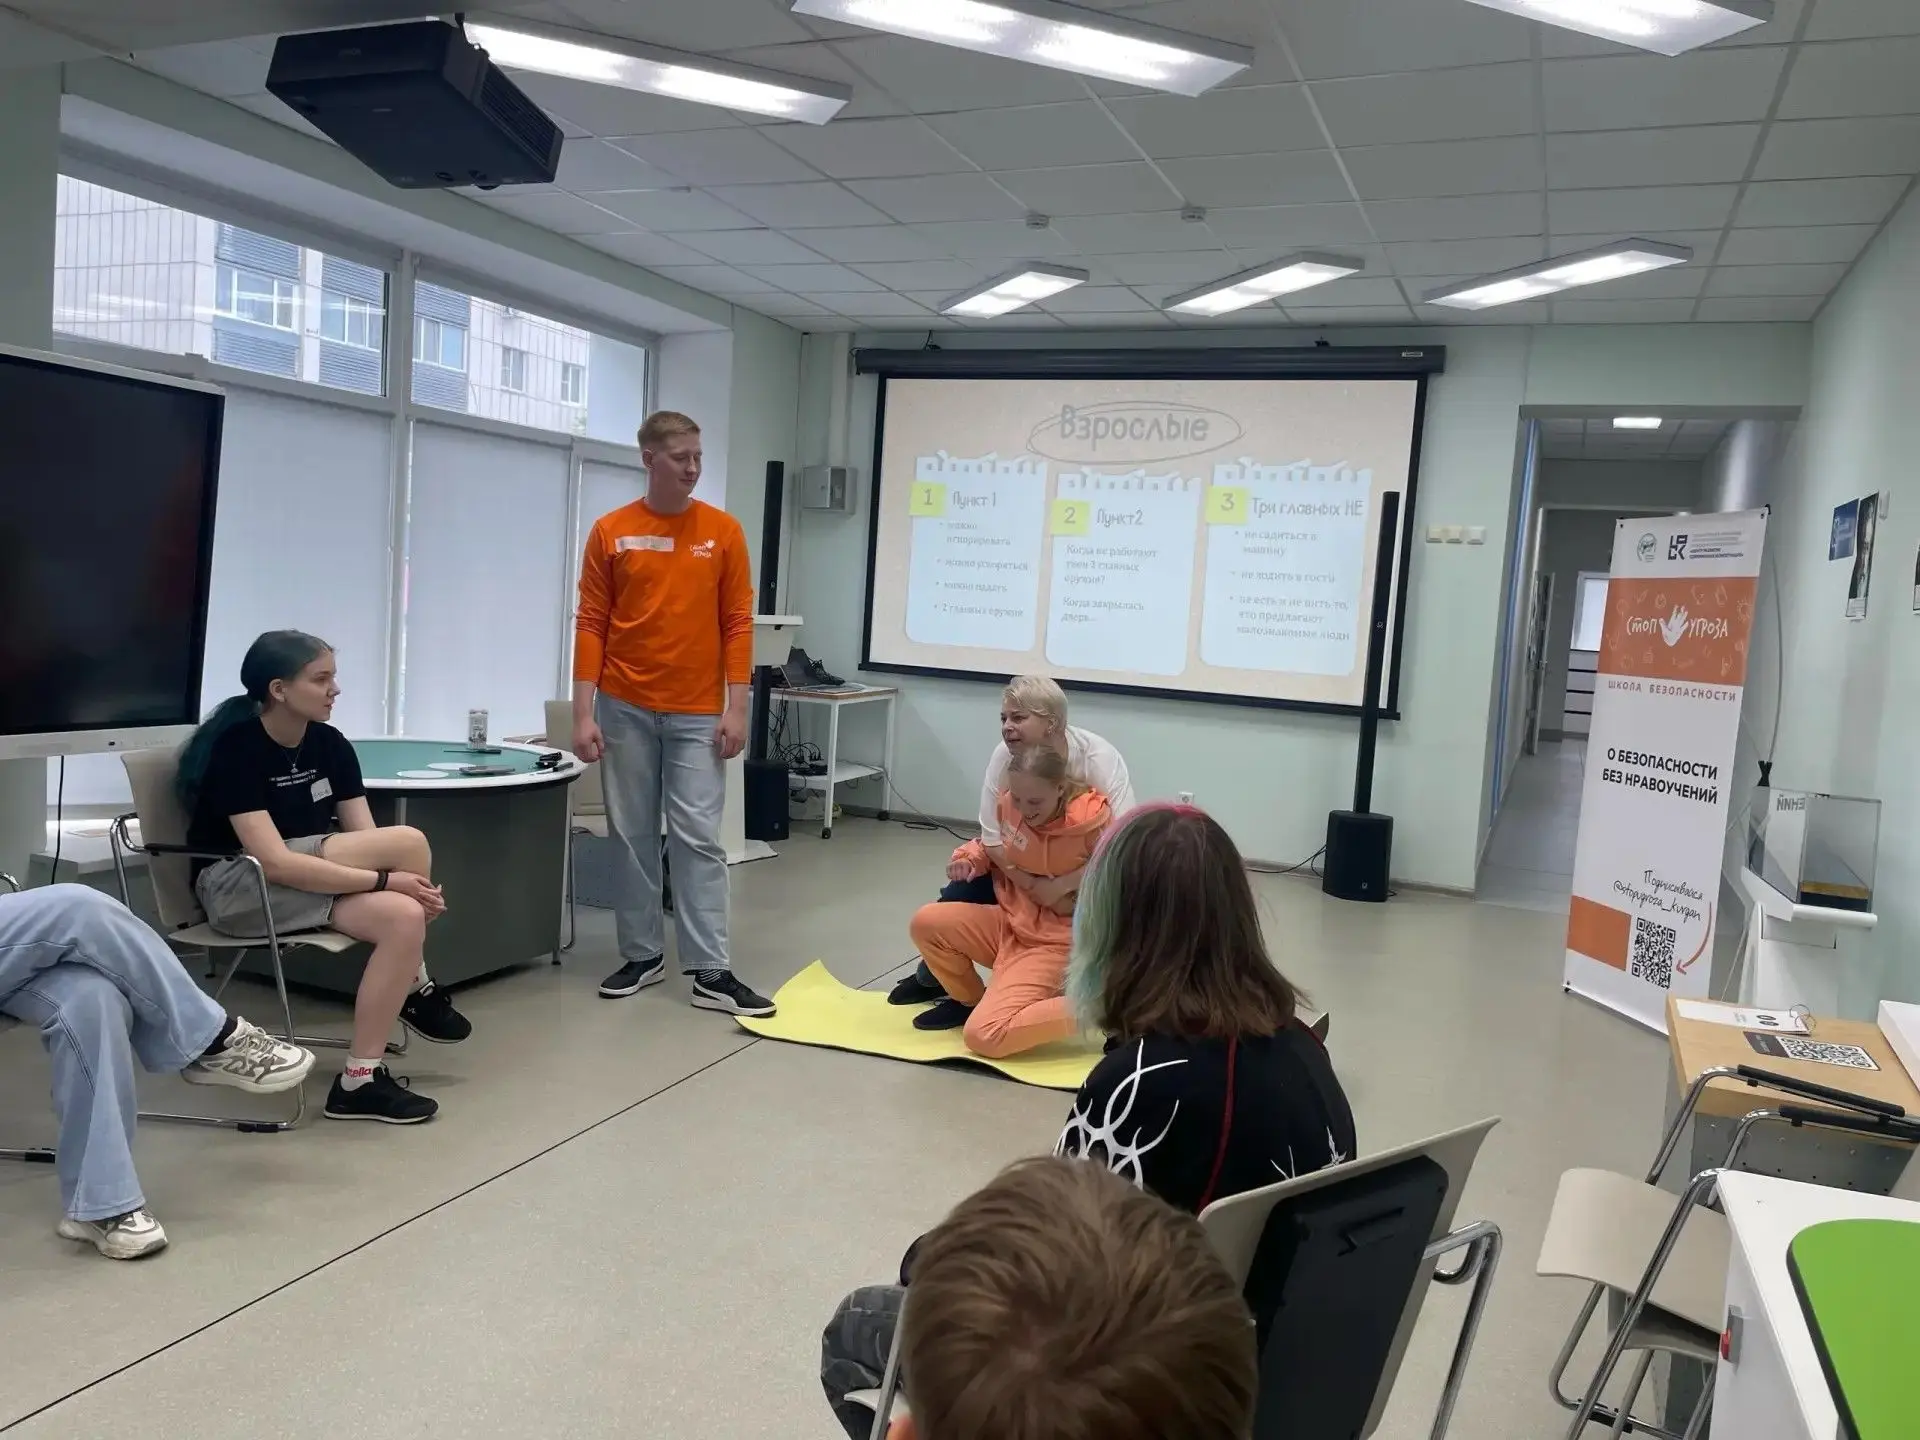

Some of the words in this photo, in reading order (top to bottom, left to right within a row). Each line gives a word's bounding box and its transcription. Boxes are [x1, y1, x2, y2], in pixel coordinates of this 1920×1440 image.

[1060, 404, 1209, 451] Взрослые
[923, 487, 933, 506] 1
[952, 491, 988, 509] Пункт
[1220, 492, 1235, 511] 3
[1063, 506, 1076, 524] 2
[1251, 497, 1276, 518] Три
[1279, 502, 1341, 516] главных
[1345, 500, 1364, 516] НЕ
[1244, 530, 1257, 539] не
[1258, 531, 1308, 541] садиться
[1066, 544, 1094, 555] Когда
[1109, 547, 1158, 558] работают
[1304, 574, 1335, 584] гости
[1258, 612, 1324, 623] предлагают
[1608, 680, 1642, 693] ШКОЛА
[1649, 684, 1736, 702] БЕЗОПАСНОСТИ
[1607, 747, 1616, 761] О
[1618, 749, 1718, 780] БЕЗОПАСНОСТИ
[1602, 768, 1623, 784] БЕЗ
[1624, 772, 1719, 804] НРАВОУЧЕНИЙ
